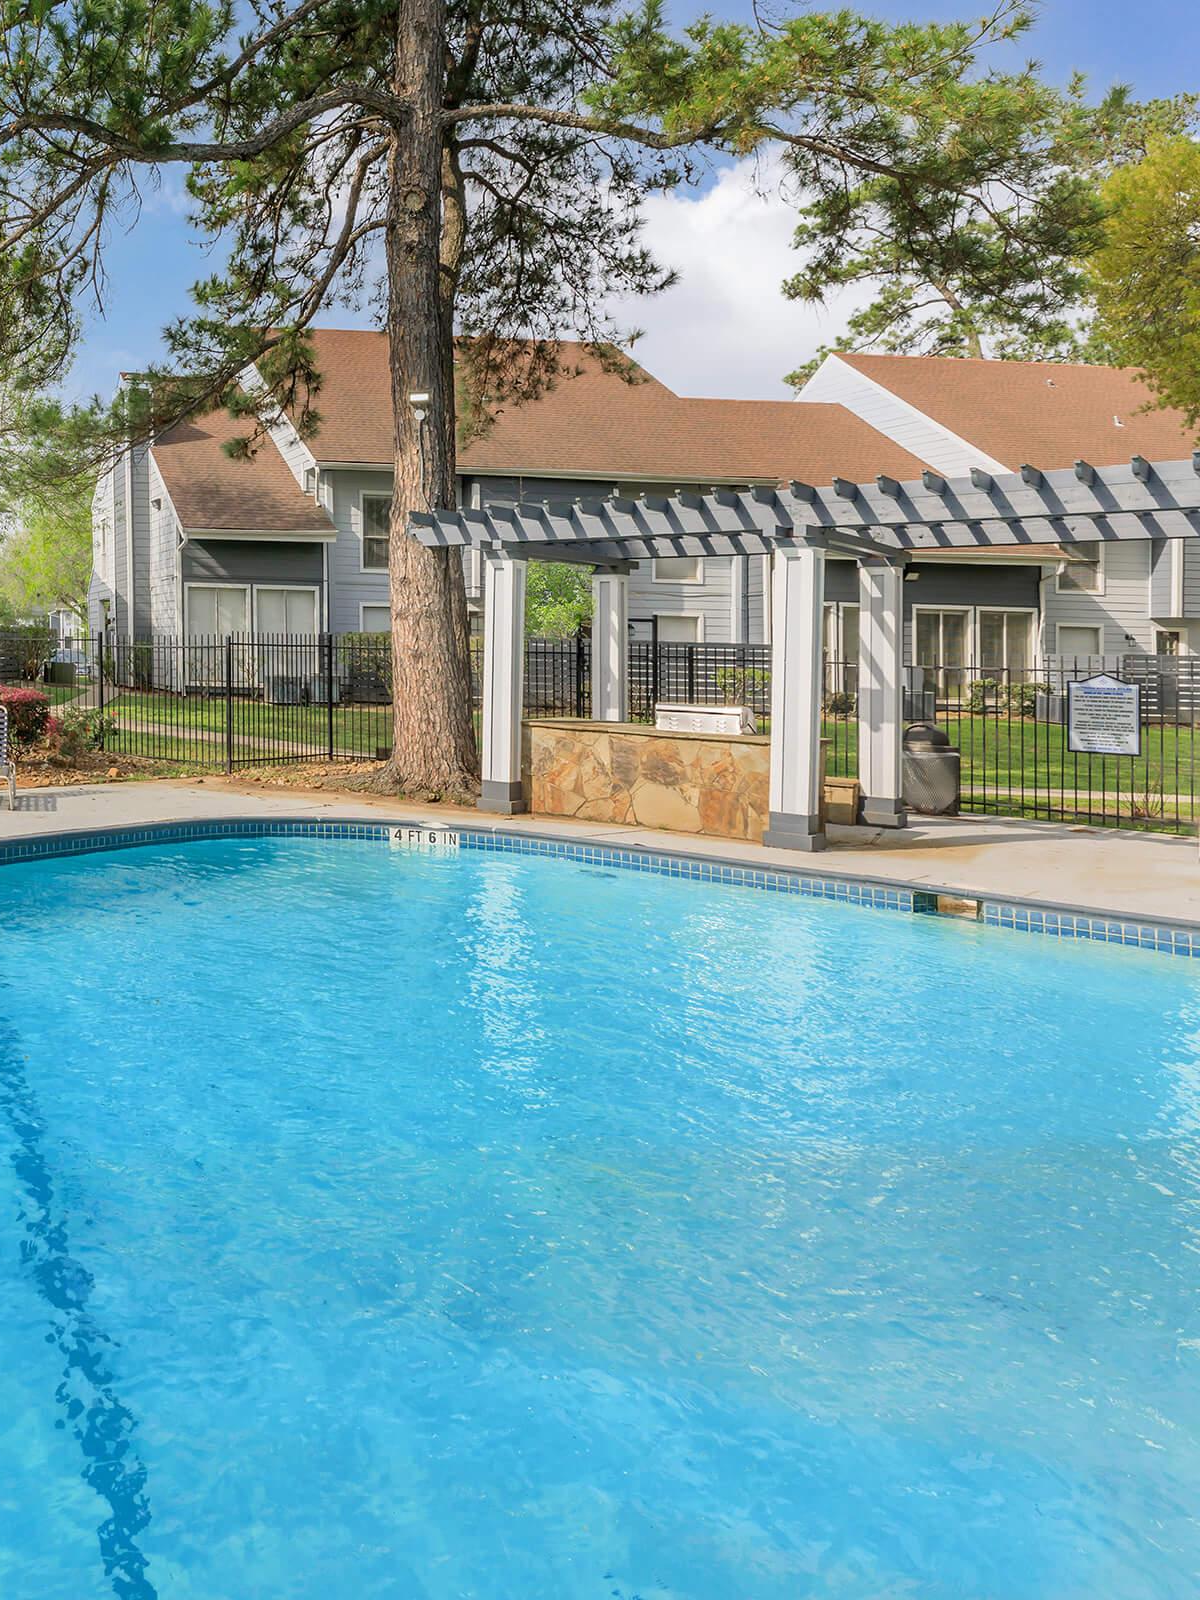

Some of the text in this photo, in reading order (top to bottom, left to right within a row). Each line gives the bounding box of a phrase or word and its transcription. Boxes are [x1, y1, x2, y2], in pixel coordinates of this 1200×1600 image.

[394, 829, 457, 845] 4 FT 6 IN
